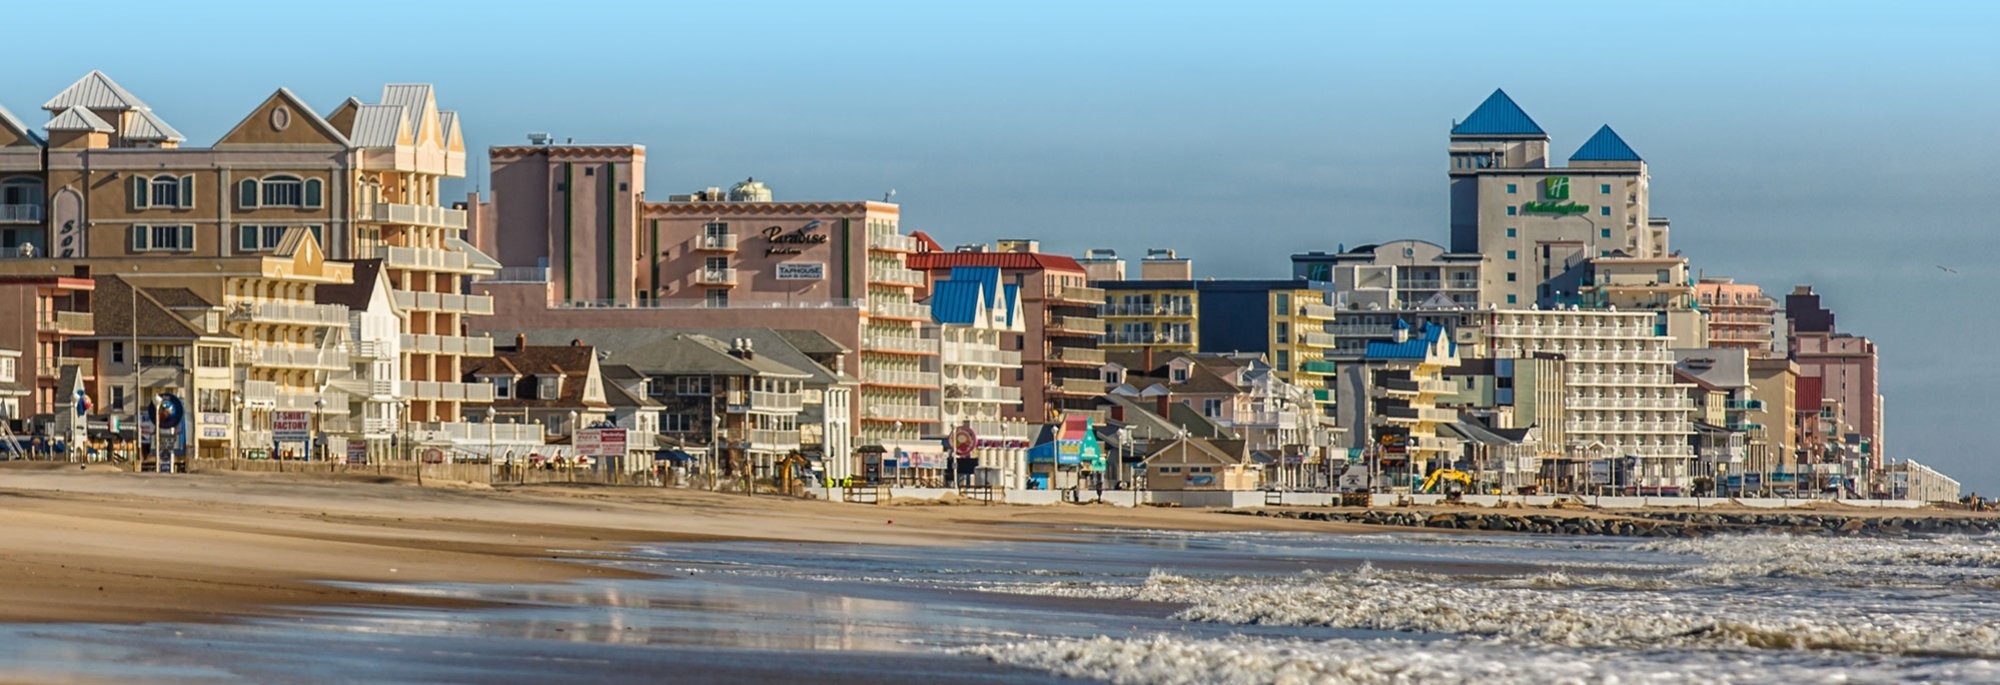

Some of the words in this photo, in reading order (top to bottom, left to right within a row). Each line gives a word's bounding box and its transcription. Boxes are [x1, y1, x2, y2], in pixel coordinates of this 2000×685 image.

[762, 226, 827, 244] Paradise
[779, 266, 822, 274] TAPHOUSE
[276, 411, 305, 420] T-SHIRT
[273, 421, 308, 430] FACTORY
